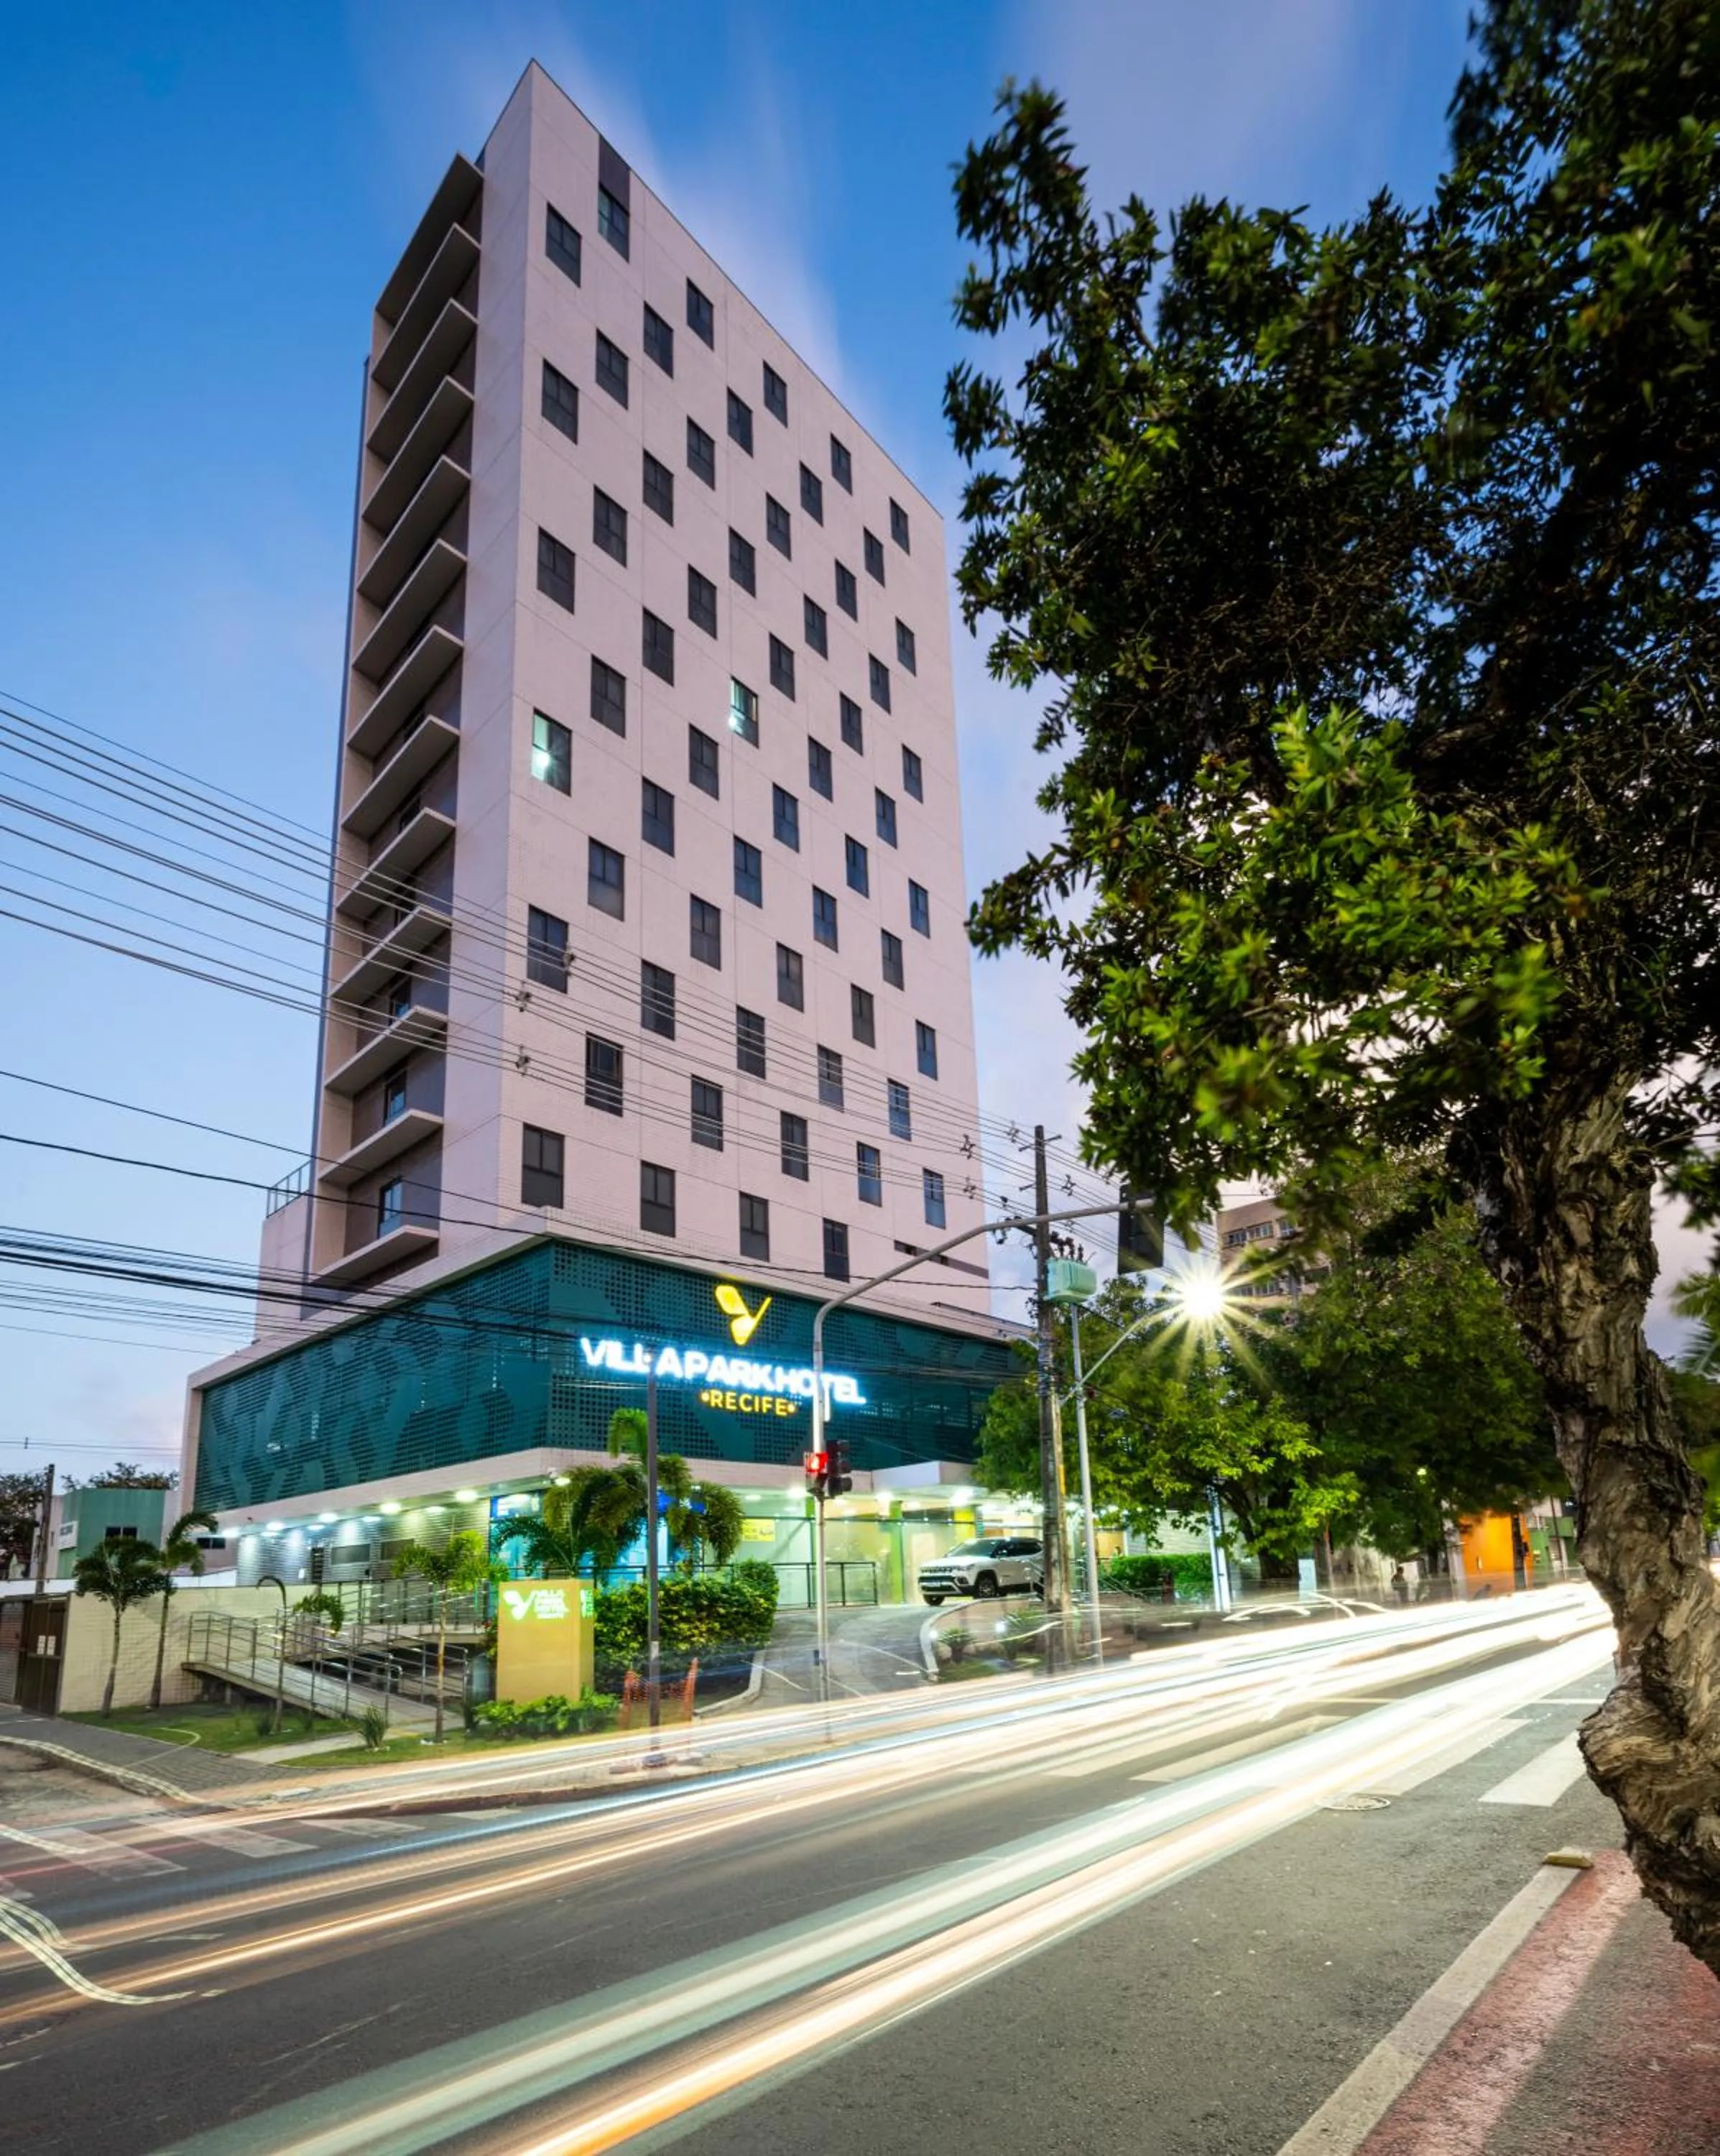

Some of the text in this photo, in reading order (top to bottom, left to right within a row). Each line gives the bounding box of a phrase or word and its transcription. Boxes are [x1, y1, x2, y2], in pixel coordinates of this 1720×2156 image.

[580, 1337, 866, 1404] VILLA PARK HOTEL
